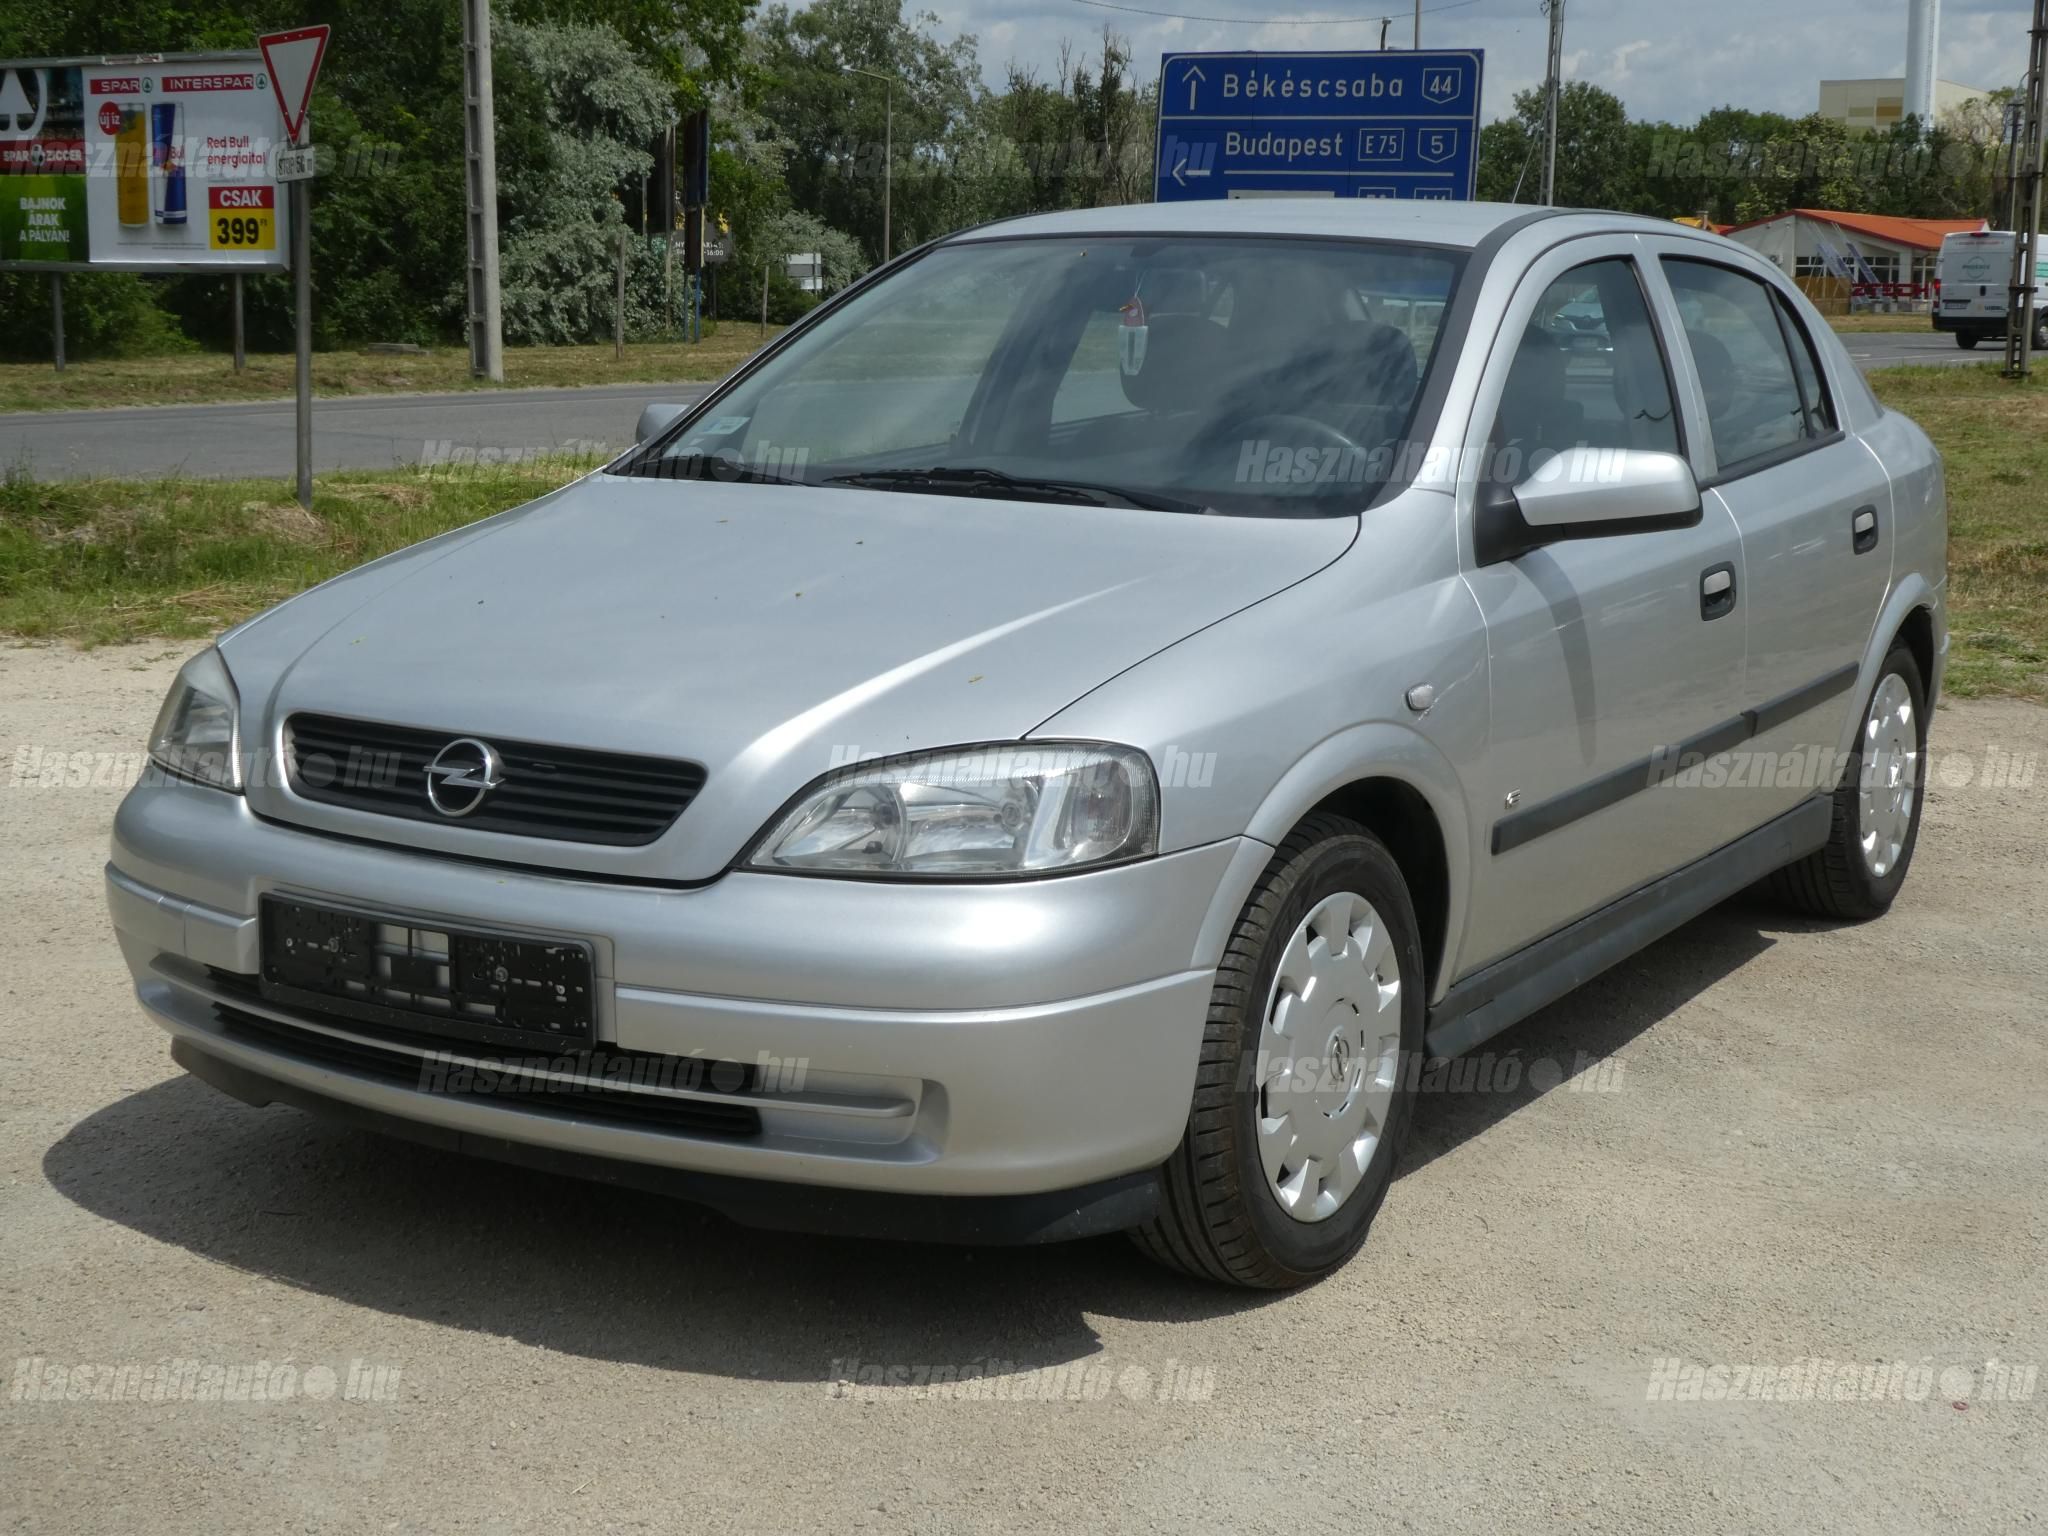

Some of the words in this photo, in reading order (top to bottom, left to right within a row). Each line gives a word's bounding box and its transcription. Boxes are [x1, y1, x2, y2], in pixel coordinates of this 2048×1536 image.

[101, 80, 140, 92] SPAR
[170, 75, 254, 90] INTERSPAR
[1223, 69, 1404, 98] Békéscsaba
[1429, 75, 1453, 95] 44
[207, 136, 227, 149] Red
[229, 136, 250, 149] Bull
[1226, 132, 1343, 162] Budapest
[1431, 135, 1443, 154] 5
[207, 152, 266, 168] energiaital
[19, 197, 67, 210] BAJNOK
[220, 189, 263, 207] CSAK
[28, 210, 60, 226] ÁRAK
[19, 231, 27, 242] A
[29, 226, 71, 243] PÁLYÁN!
[217, 217, 259, 245] 399
